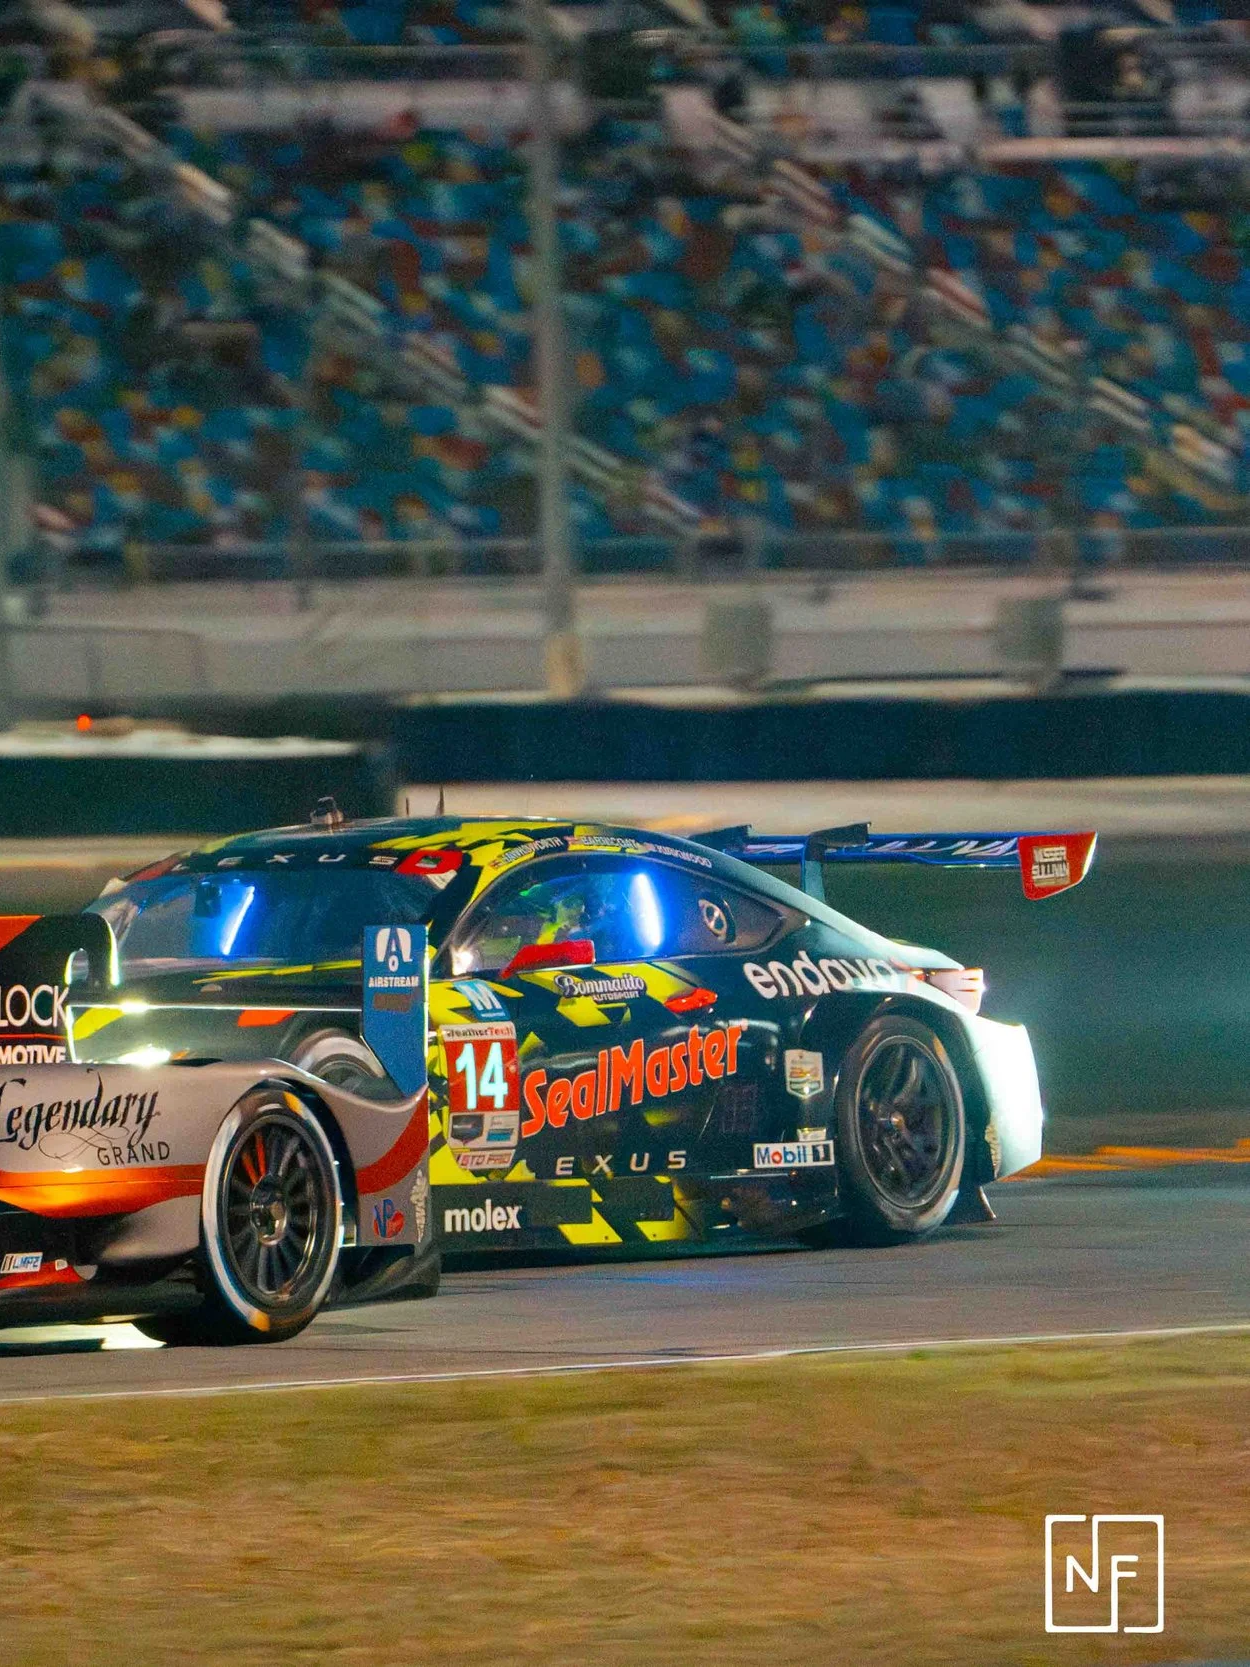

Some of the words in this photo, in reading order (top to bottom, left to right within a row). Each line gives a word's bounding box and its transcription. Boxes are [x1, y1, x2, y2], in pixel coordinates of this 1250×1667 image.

[368, 976, 419, 988] AIRSTREAM
[743, 950, 897, 999] endava
[455, 1042, 508, 1109] 14
[521, 1024, 743, 1139] SealMaster
[97, 1141, 171, 1167] GRAND
[756, 1144, 808, 1166] Mobil
[444, 1199, 521, 1233] molex
